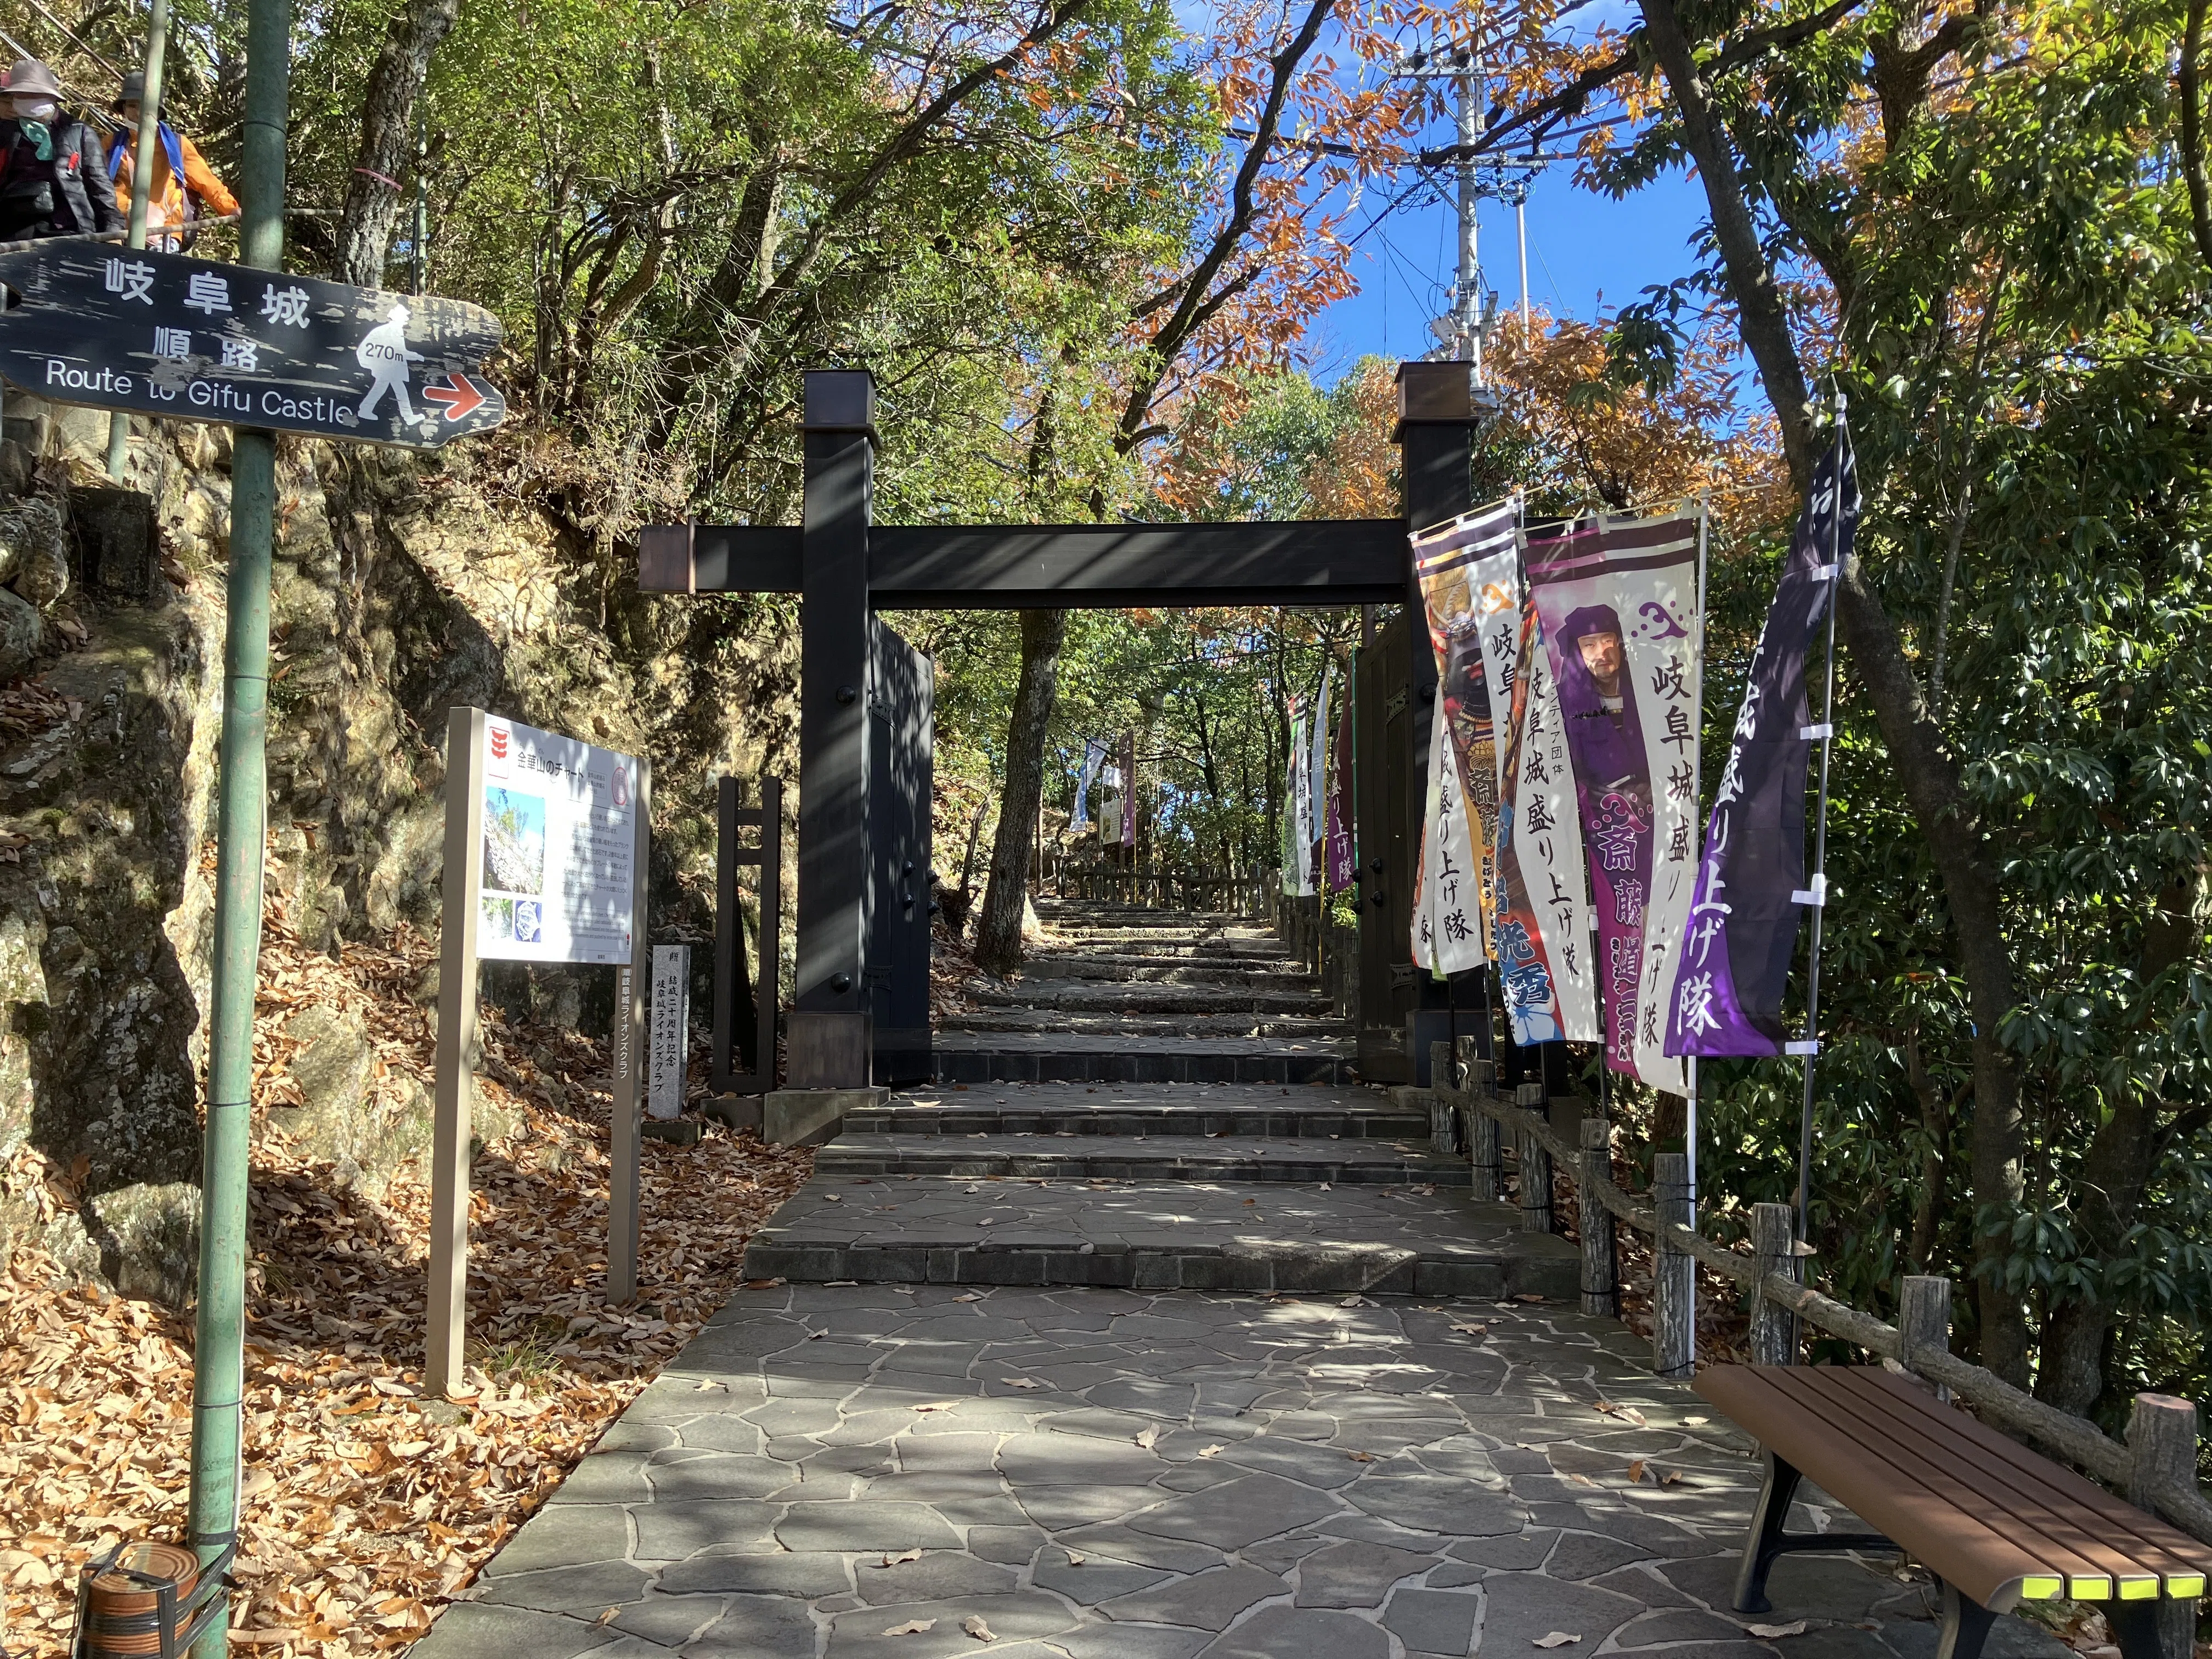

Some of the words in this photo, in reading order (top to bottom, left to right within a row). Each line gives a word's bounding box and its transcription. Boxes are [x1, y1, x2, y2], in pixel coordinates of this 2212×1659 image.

[105, 257, 311, 329] 岐阜城
[153, 326, 259, 373] 順路
[365, 343, 404, 363] 270m
[46, 359, 133, 395] Route
[188, 380, 250, 413] Gifu
[262, 390, 354, 425] Castle
[1492, 623, 1516, 738] 岐阜
[517, 751, 584, 783] 金華山のチャート
[1676, 623, 1761, 1037] 城盛り上げ隊
[654, 979, 667, 1093] 岐阜城ライオンズクラブ
[665, 975, 678, 1067] 結成二十周年記念
